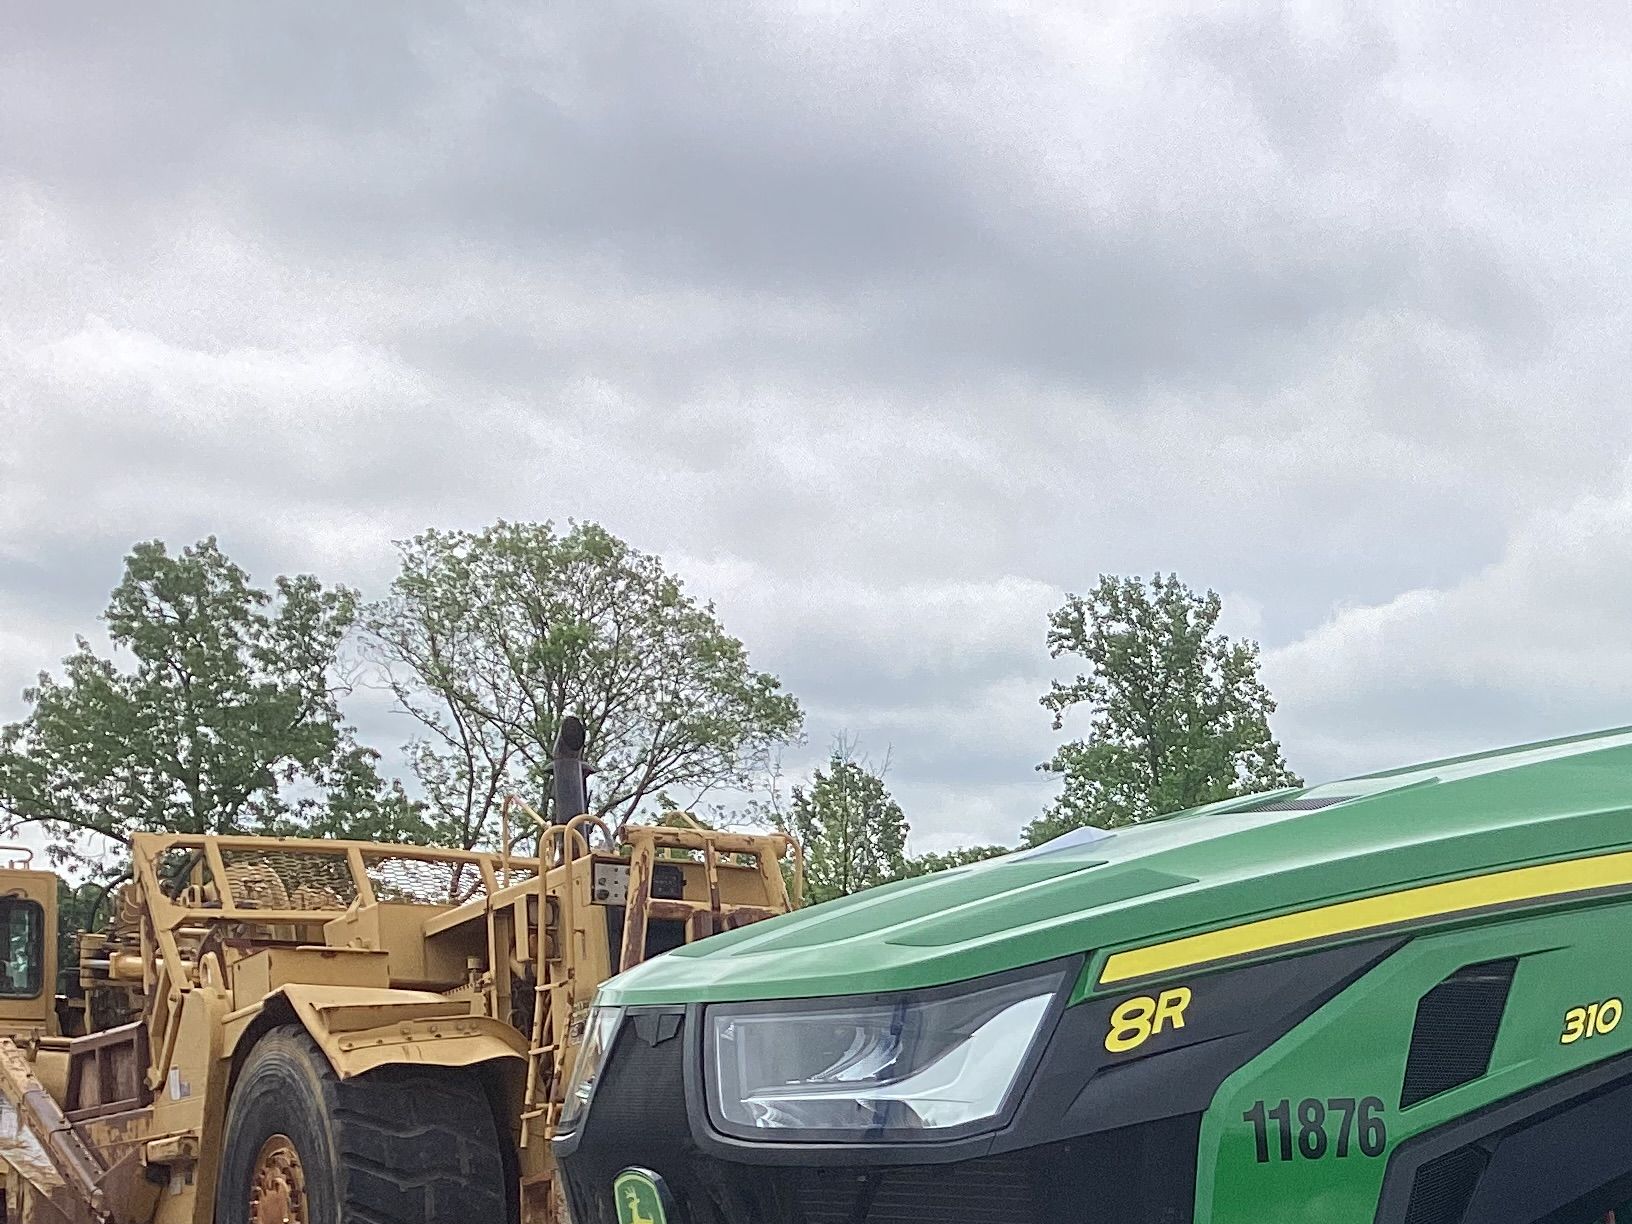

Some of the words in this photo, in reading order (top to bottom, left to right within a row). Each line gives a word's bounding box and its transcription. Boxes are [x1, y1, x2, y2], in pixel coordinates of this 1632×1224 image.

[1104, 986, 1192, 1053] 8R
[1560, 997, 1624, 1045] 310
[1241, 1096, 1388, 1165] 11876
